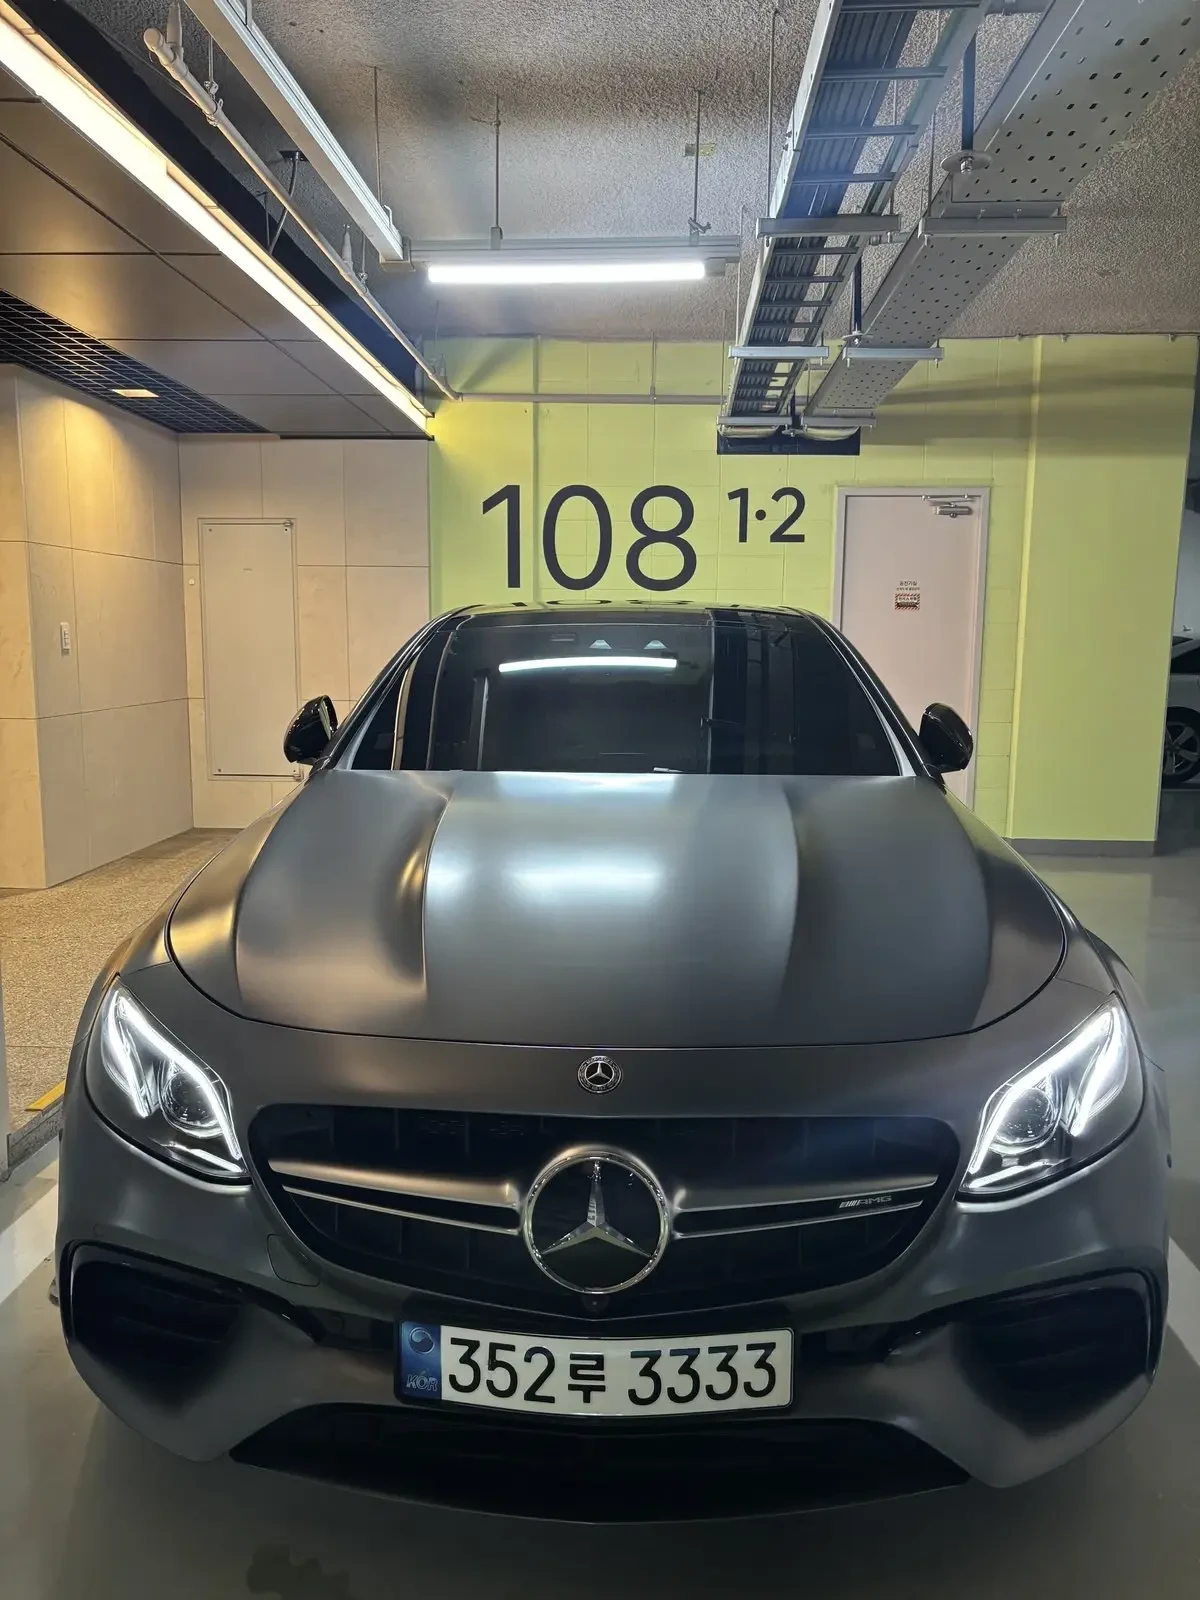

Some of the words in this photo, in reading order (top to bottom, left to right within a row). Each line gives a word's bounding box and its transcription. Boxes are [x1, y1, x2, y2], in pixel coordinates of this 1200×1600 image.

[482, 484, 697, 591] 108
[406, 1373, 439, 1392] KOR
[448, 1337, 606, 1404] 352루
[627, 1341, 777, 1406] 3333
